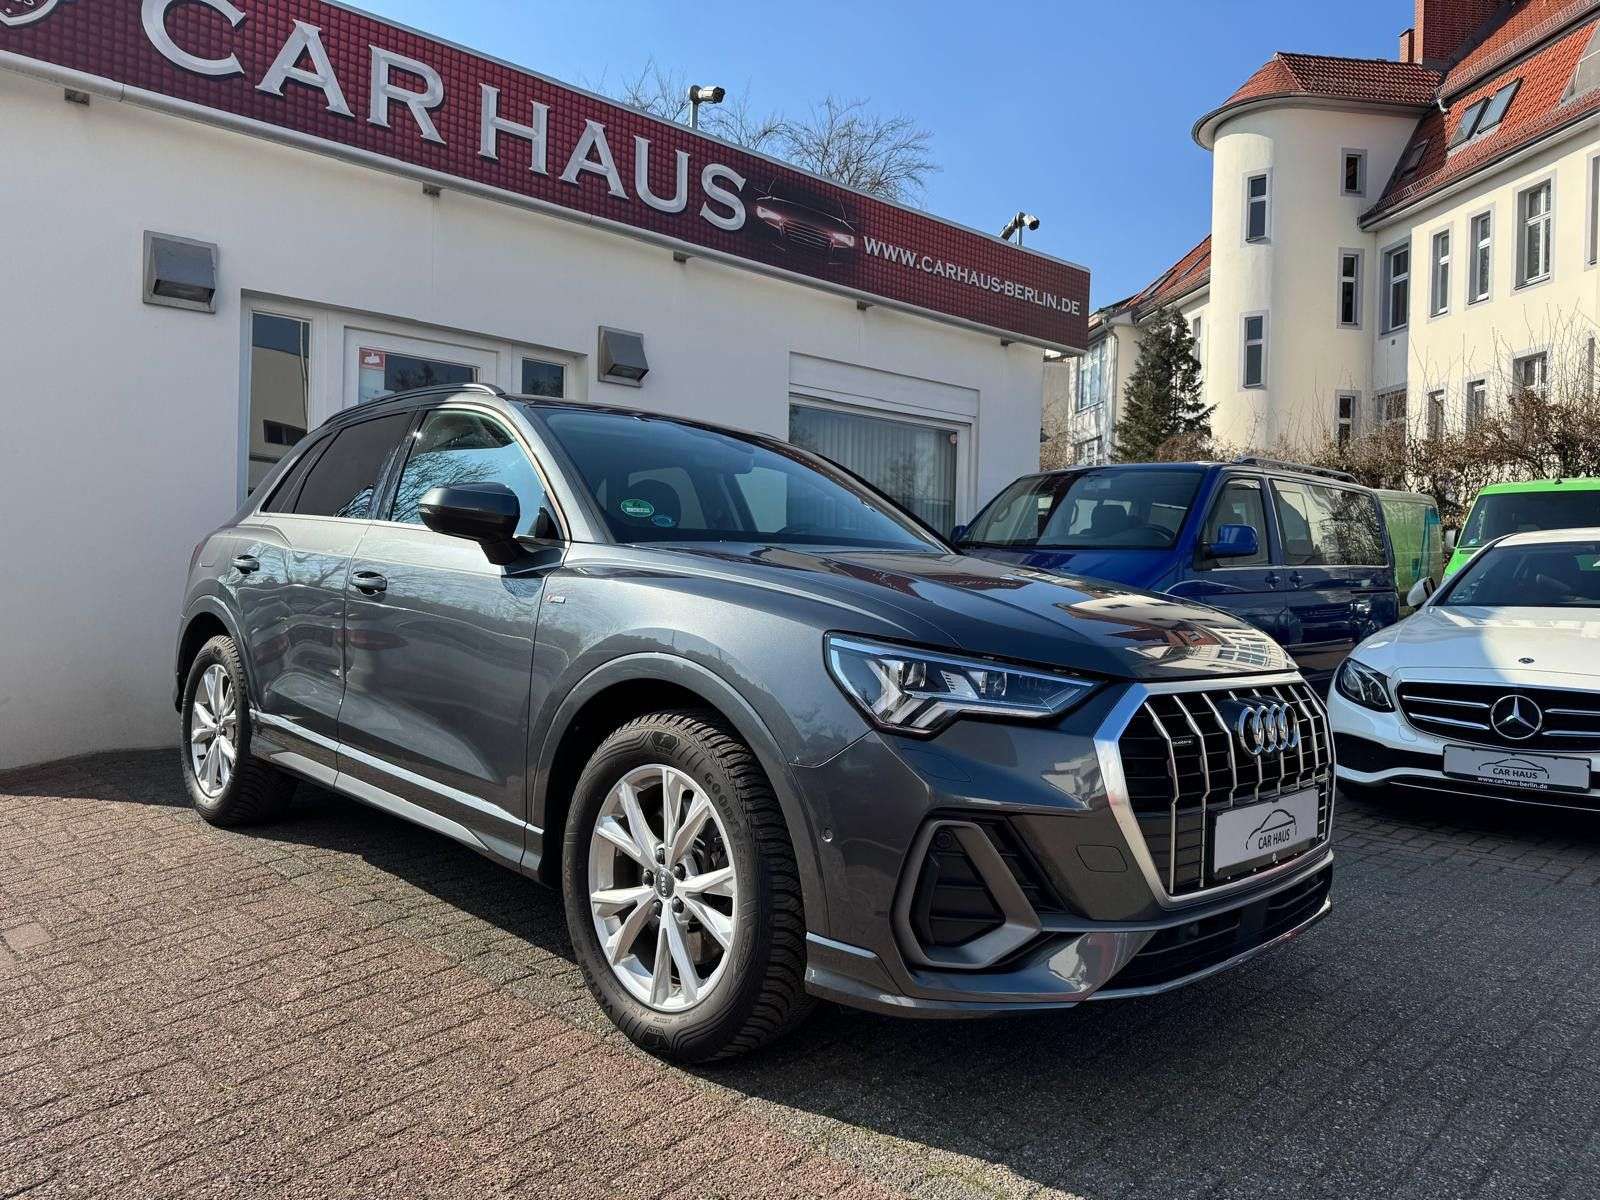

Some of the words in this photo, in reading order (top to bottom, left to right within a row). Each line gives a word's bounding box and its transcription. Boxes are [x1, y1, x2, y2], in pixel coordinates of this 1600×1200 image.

[141, 0, 446, 144] CAR
[478, 82, 748, 232] HAUS
[863, 235, 1081, 316] WWW.CARHAUS-BERLIN.DE
[1477, 777, 1548, 789] www.carhaus-berlin.de
[1492, 767, 1510, 776] CAR
[1512, 769, 1538, 779] HAUS
[1258, 834, 1272, 849] CAR
[1273, 828, 1290, 845] HAUS
